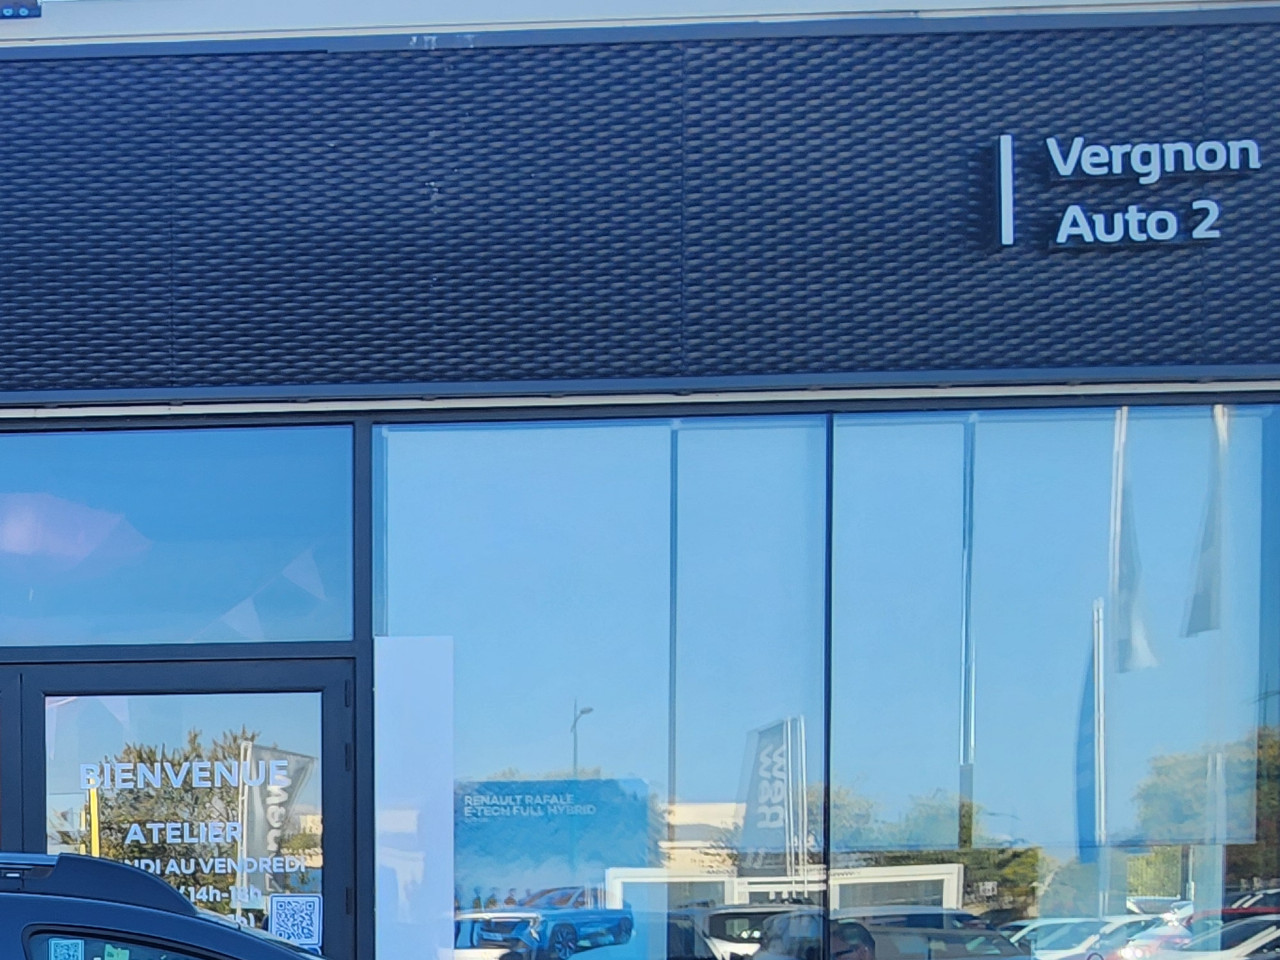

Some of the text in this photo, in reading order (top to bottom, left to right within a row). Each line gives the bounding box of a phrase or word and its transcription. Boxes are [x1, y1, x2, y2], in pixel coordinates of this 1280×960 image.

[1045, 136, 1262, 185] Vergnon
[1055, 199, 1221, 243] Auto 2
[80, 760, 289, 790] BIENVENUE
[464, 793, 574, 806] RENAULT RAFALE
[464, 804, 597, 817] E-TECH FULL HYBRID
[125, 822, 242, 845] ATELIER
[165, 857, 195, 875] AU
[198, 856, 307, 875] VENDREDI
